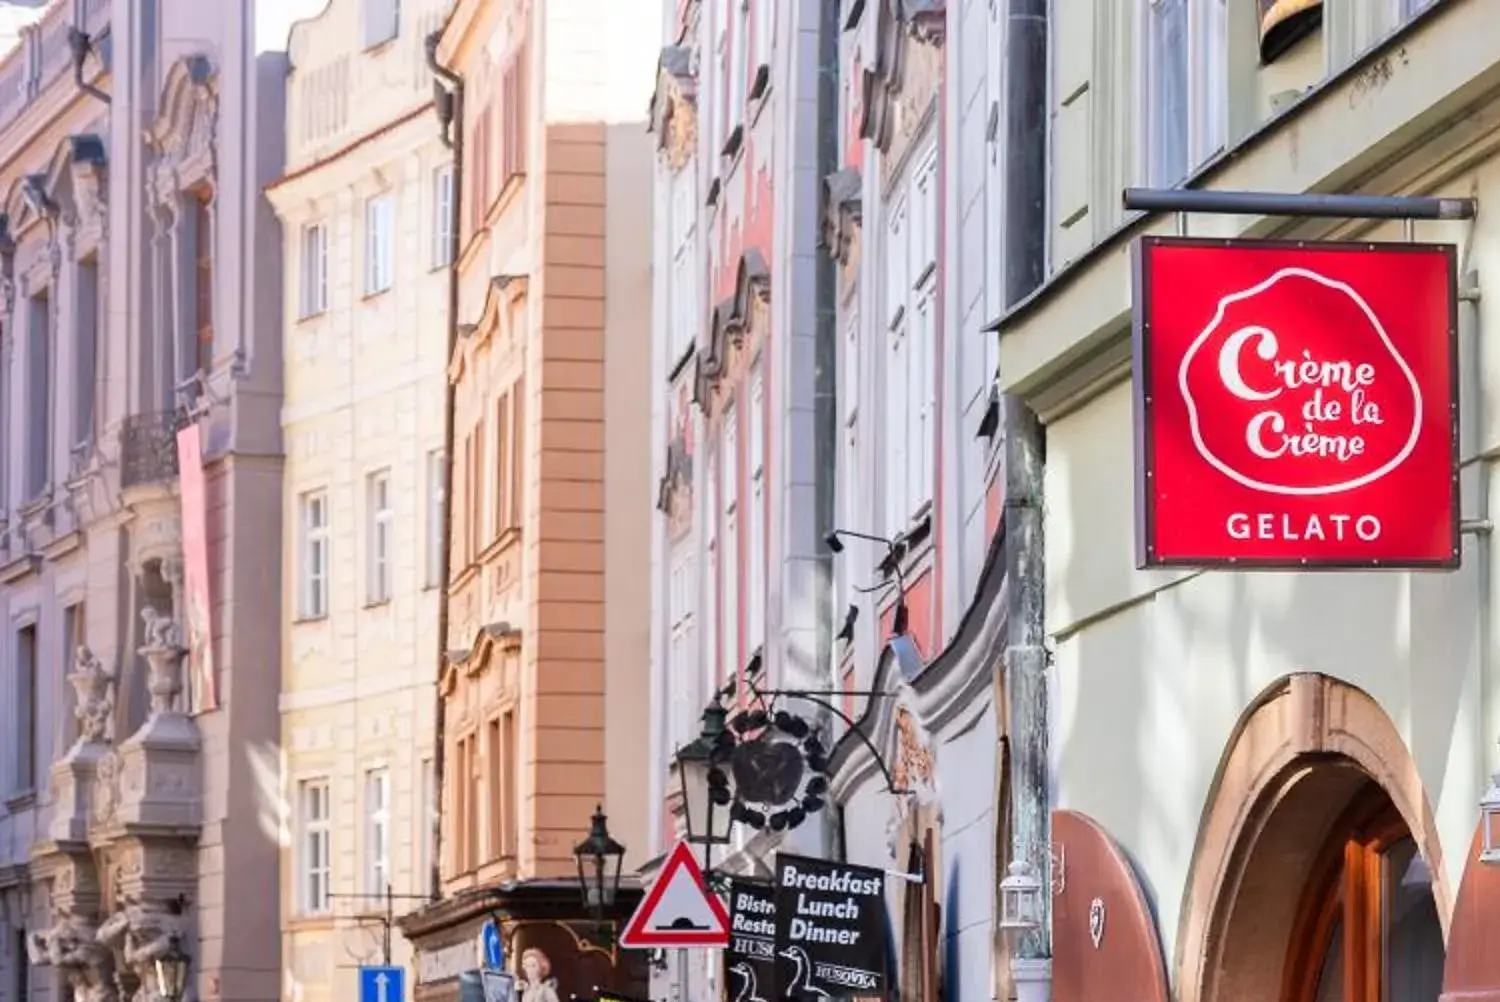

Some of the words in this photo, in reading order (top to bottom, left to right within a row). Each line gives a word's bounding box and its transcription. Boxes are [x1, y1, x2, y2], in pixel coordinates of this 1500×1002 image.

[1218, 325, 1375, 401] Crème
[1302, 391, 1341, 424] de
[1351, 389, 1384, 425] la
[1245, 410, 1365, 463] Crème
[1226, 513, 1382, 541] GELATO
[782, 864, 881, 896] Breakfast
[736, 893, 776, 914] Bistr
[797, 893, 860, 919] Lunch
[789, 918, 861, 945] Dinner
[815, 964, 877, 988] HUSOVKA
